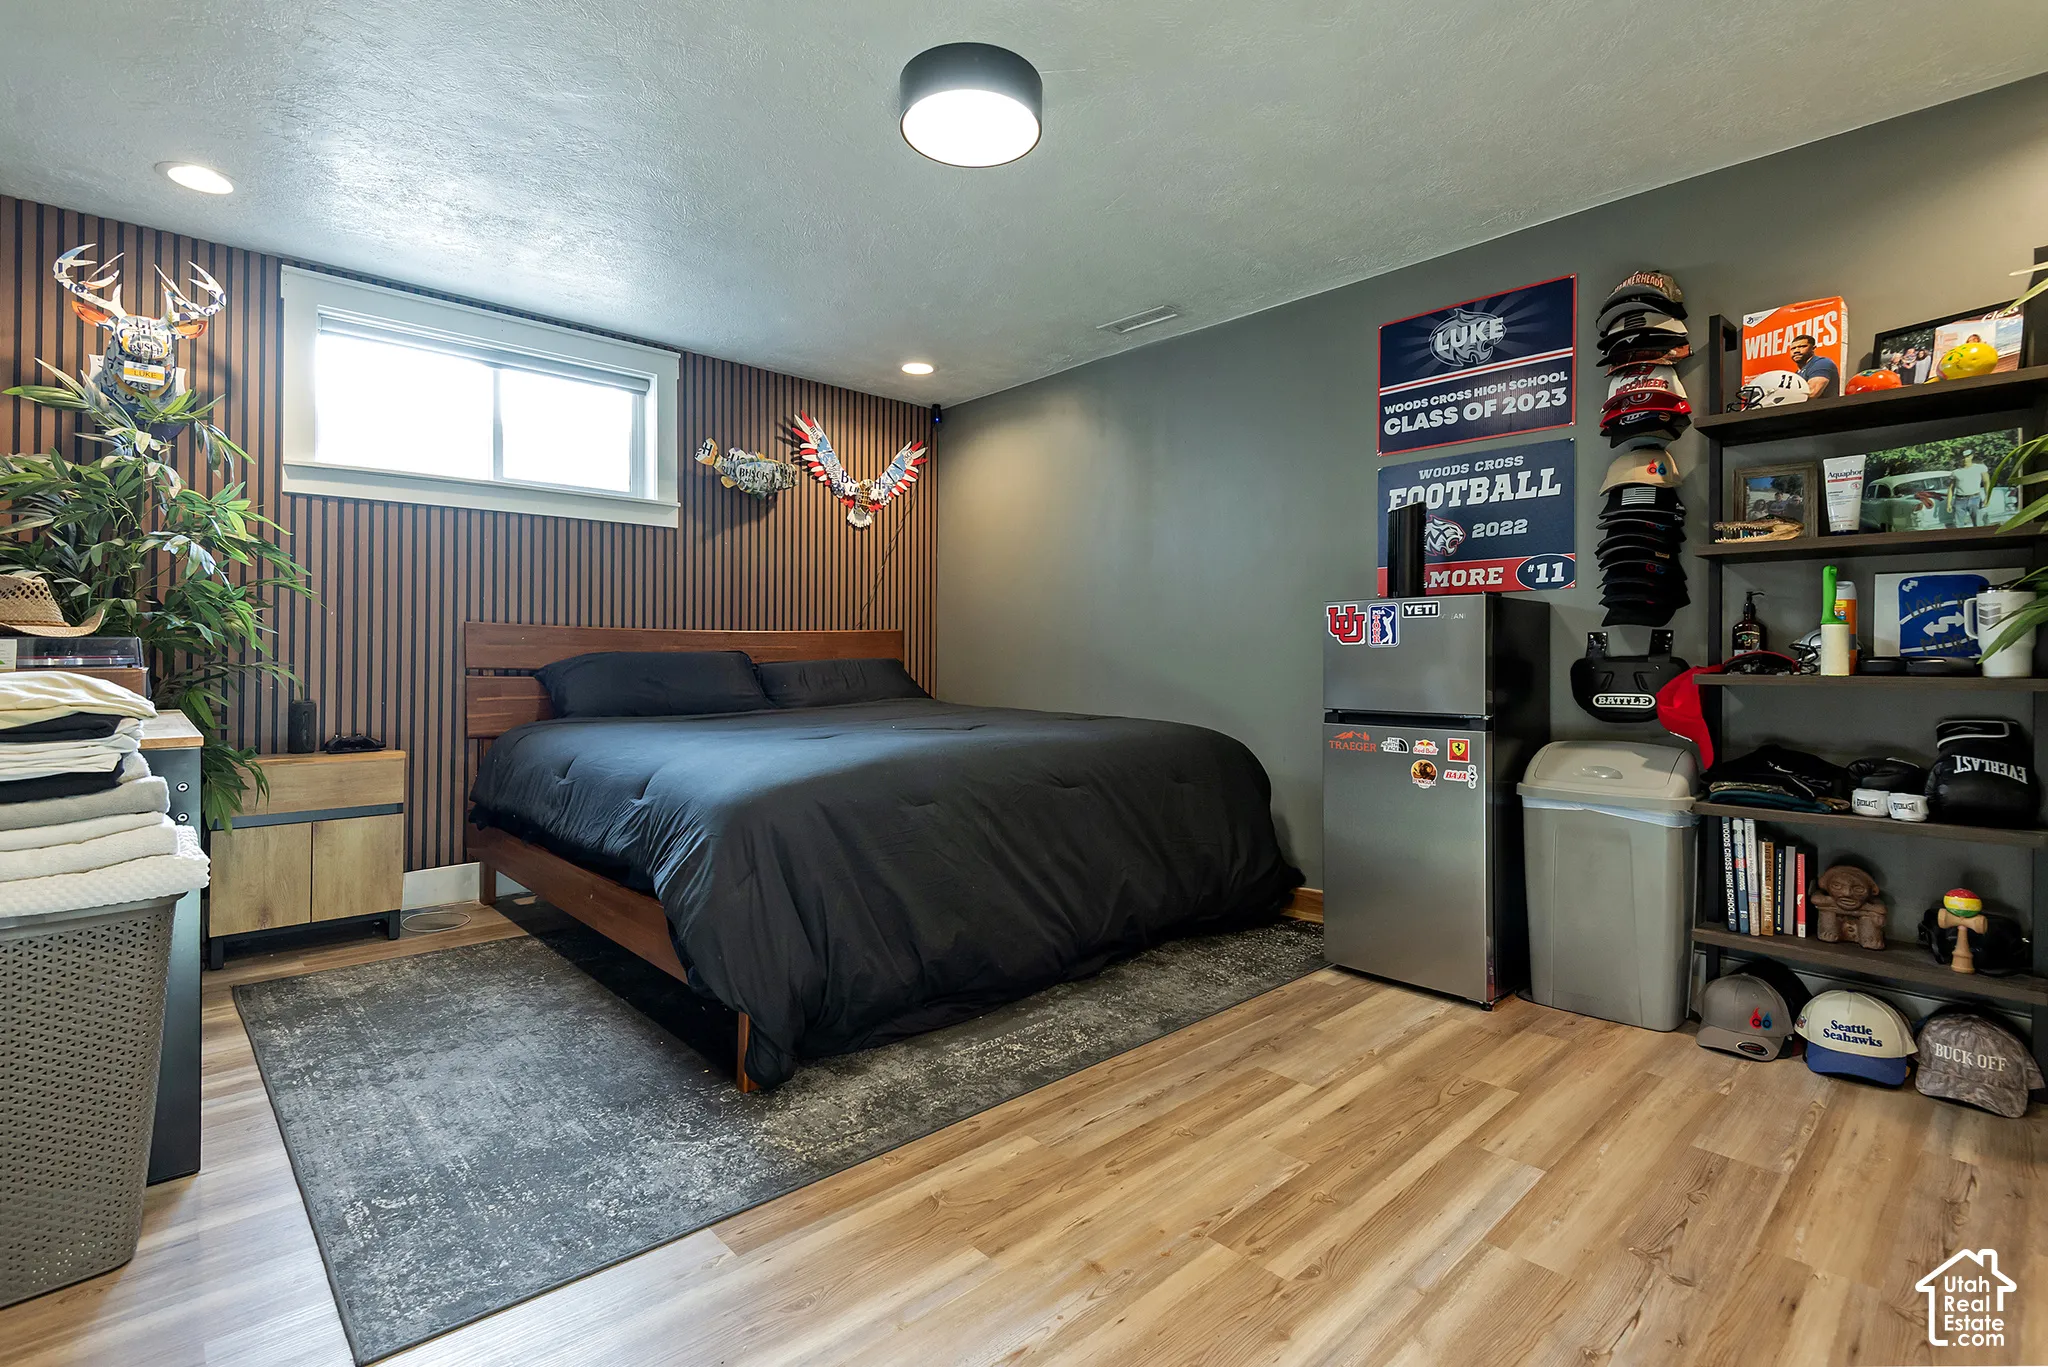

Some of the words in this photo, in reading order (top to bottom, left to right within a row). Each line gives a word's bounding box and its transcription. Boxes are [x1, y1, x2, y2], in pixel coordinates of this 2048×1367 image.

[1436, 317, 1504, 351] LUKE
[134, 370, 157, 379] LUKE
[1384, 398, 1429, 414] WOODS
[1430, 390, 1472, 406] CROSS
[1474, 381, 1506, 398] HIGH
[1509, 371, 1568, 391] SCHOOL
[1384, 406, 1459, 436] CLASS
[1463, 399, 1497, 421] OF
[1502, 387, 1567, 415] 2023
[1419, 463, 1470, 480] WOODS
[1475, 456, 1524, 472] CROSS
[1828, 468, 1862, 479] Aquaphor
[1388, 468, 1562, 513] FOOTBALL
[1472, 518, 1528, 539] 2022
[1424, 567, 1504, 588] MORE
[1527, 562, 1565, 584] #11
[1405, 604, 1437, 615] YETI
[1598, 696, 1649, 705] BATTLE
[1328, 740, 1377, 753] TRAEGER
[1445, 771, 1467, 780] BAJA
[1951, 754, 2028, 785] EVERLAST
[1857, 798, 1877, 809] EVERLAST
[1893, 802, 1915, 812] EVERLAST
[1722, 823, 1731, 847] WOODS
[1724, 848, 1732, 871] CROSS
[1725, 871, 1734, 888] HIGH
[1727, 888, 1735, 916] SCHOOL
[1823, 1027, 1882, 1047] Seahawks
[1830, 1019, 1873, 1036] Seattle
[1935, 1043, 1973, 1065] BUCK
[1977, 1054, 2007, 1072] OFF
